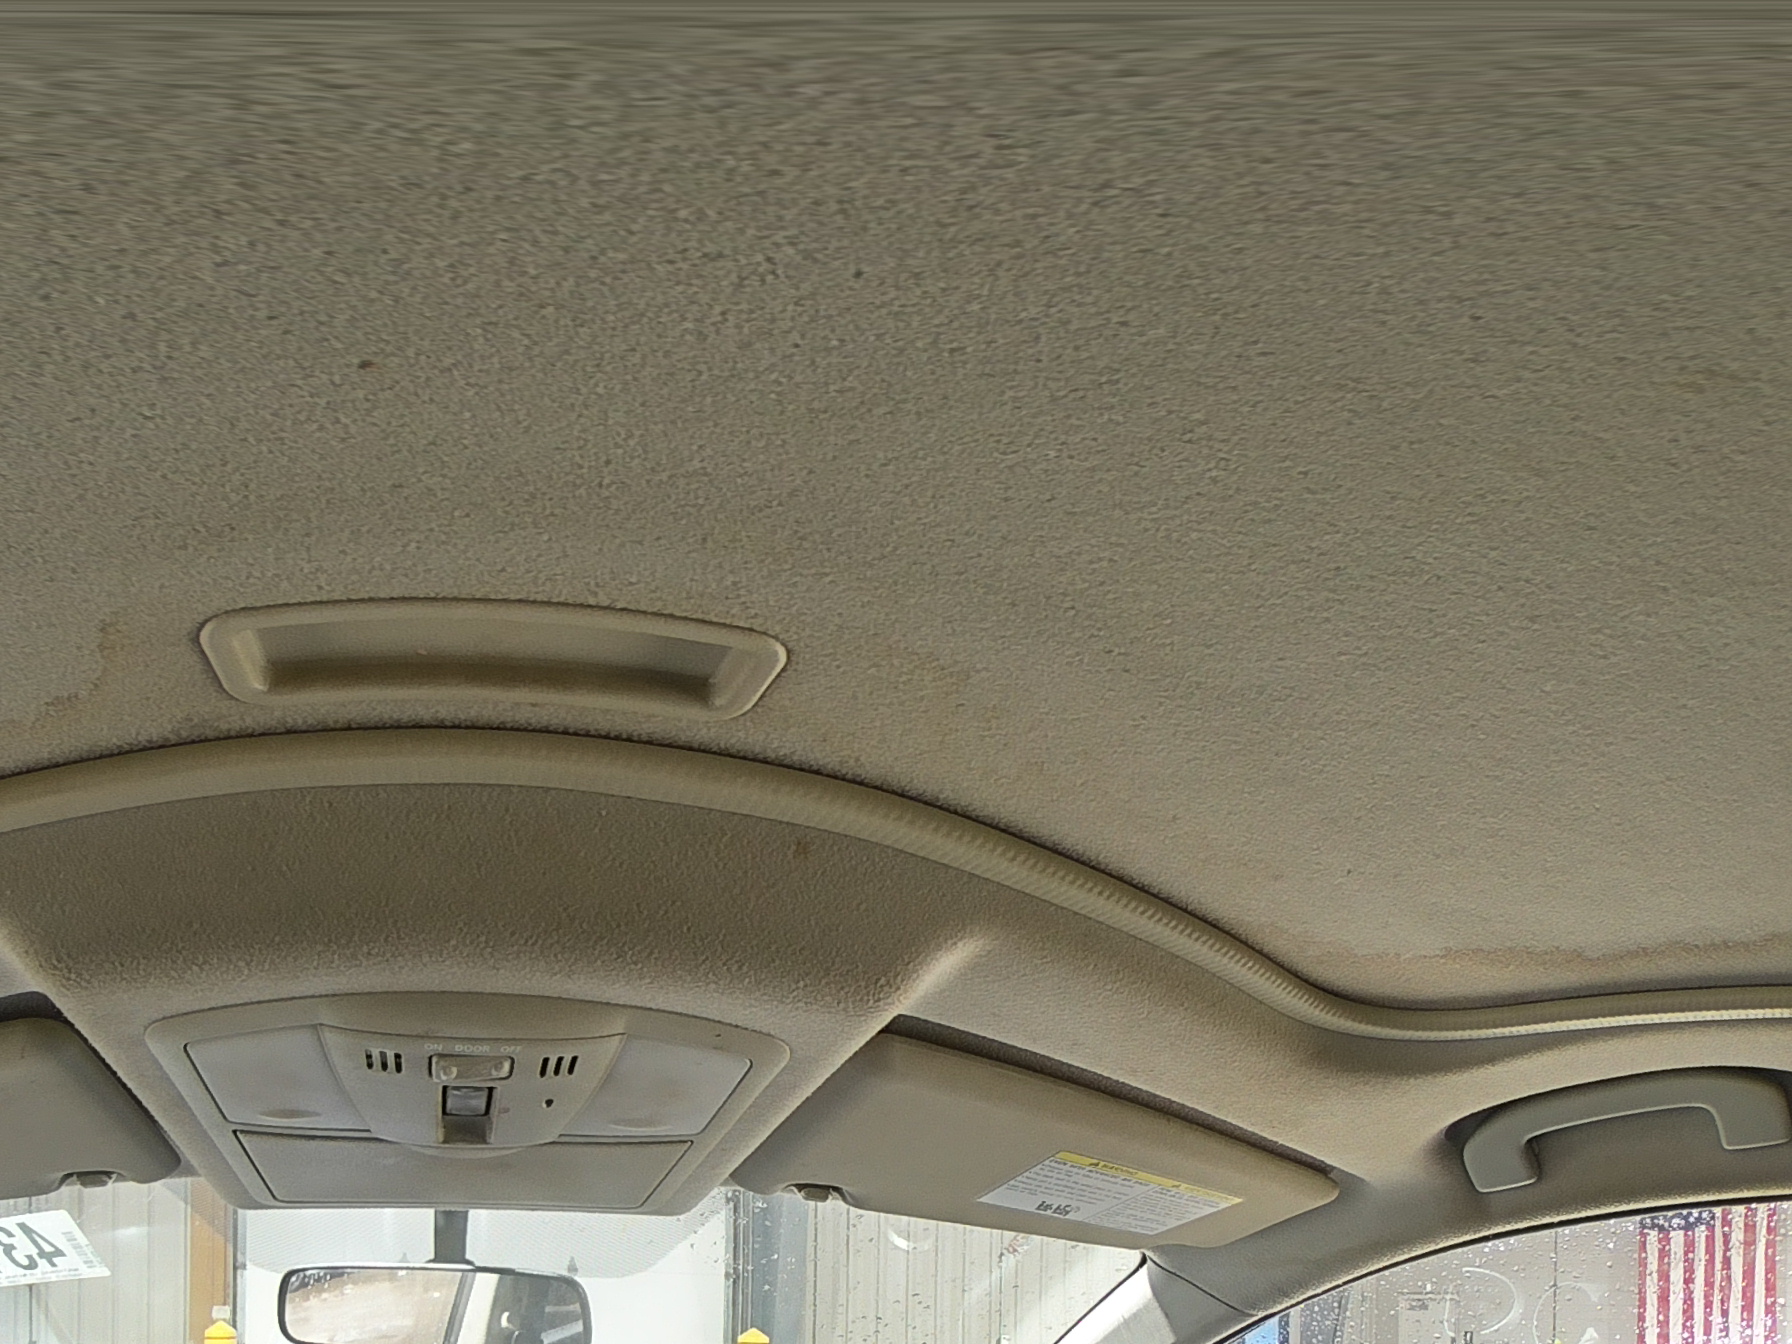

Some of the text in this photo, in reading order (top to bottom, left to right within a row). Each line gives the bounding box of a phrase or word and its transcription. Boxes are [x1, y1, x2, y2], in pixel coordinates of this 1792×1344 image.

[424, 1043, 522, 1054] ON DOOR OFF
